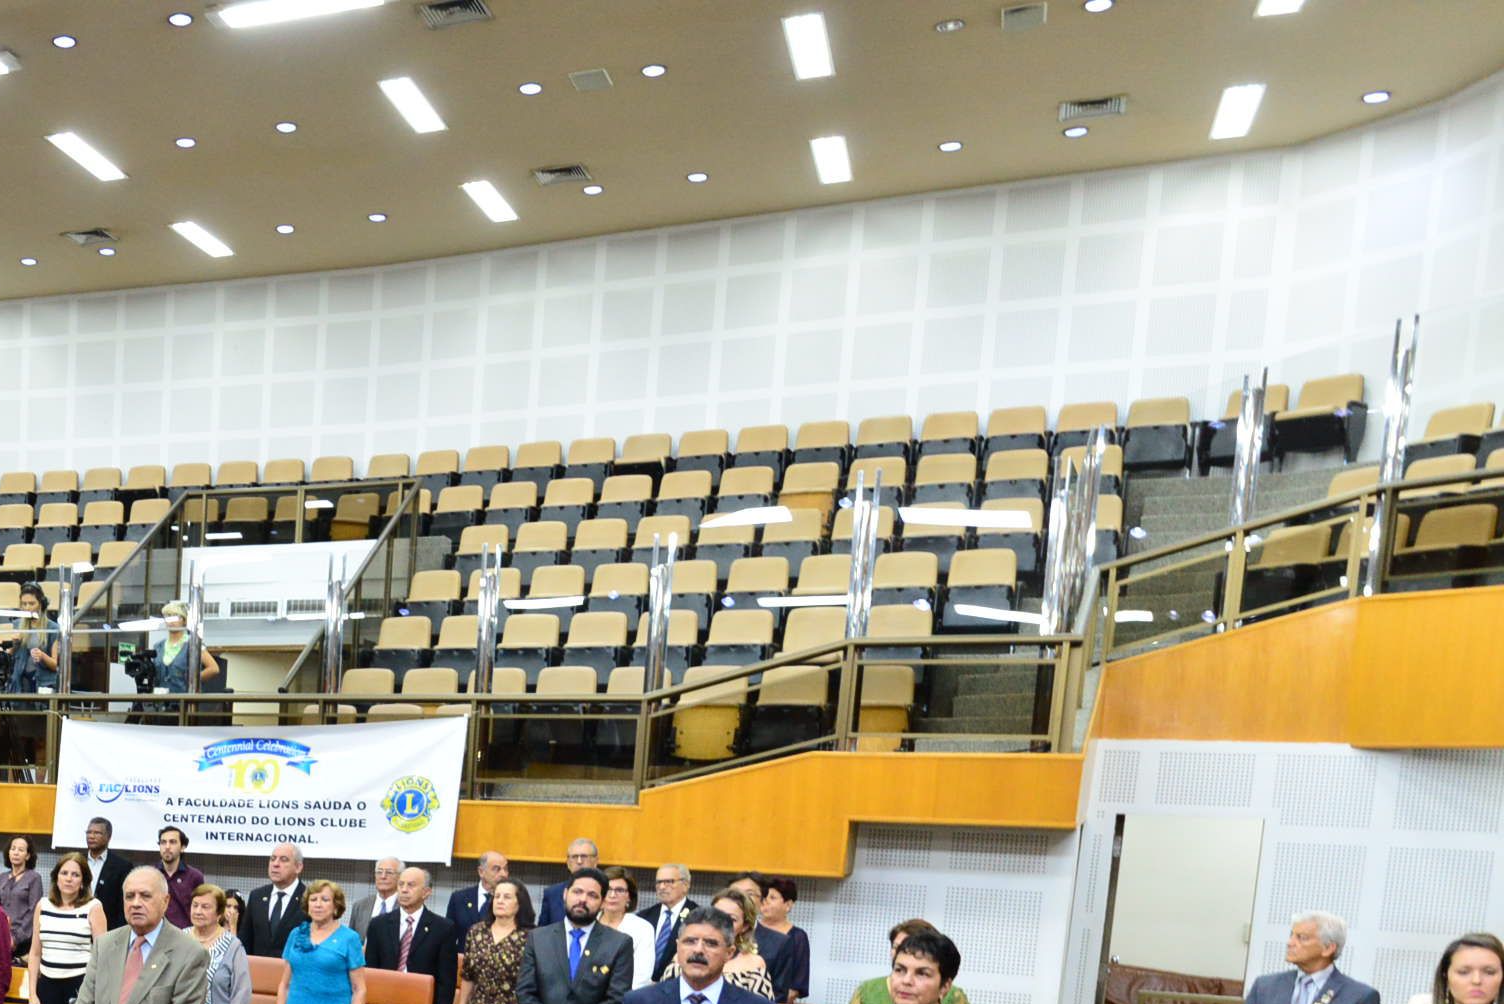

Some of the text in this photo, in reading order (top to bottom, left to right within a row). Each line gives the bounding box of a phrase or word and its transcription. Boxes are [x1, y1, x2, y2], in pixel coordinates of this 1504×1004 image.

[206, 739, 253, 758] Centennial
[166, 797, 366, 810] A FACULDADE LIONS SAÚDA O
[163, 812, 367, 828] CENTENÁRIO DO LIONS CLUBE
[205, 831, 318, 844] INTERNACIONAL.
